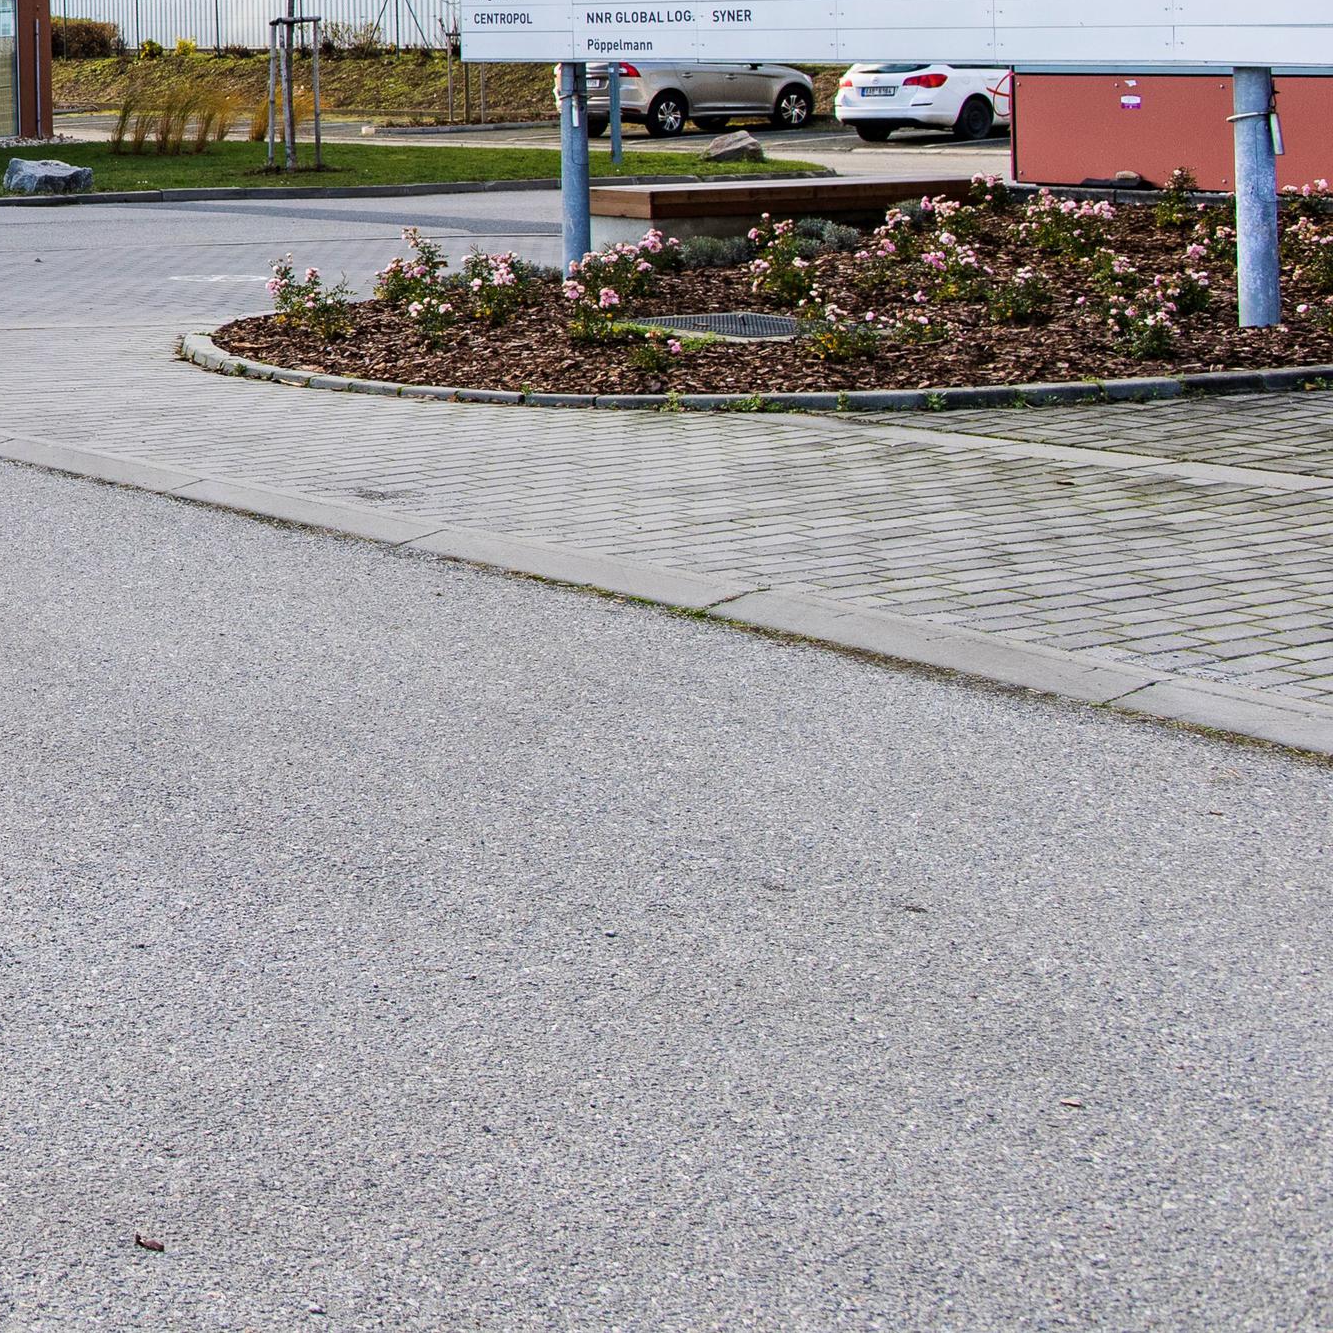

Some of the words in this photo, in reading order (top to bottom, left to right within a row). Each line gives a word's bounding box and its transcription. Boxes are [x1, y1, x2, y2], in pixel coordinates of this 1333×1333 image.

[473, 13, 533, 25] CENTROPOL
[586, 12, 612, 23] NNR
[615, 11, 664, 23] GLOBAL
[667, 10, 695, 22] LOG.
[712, 10, 752, 22] SYNER
[587, 39, 653, 54] Pöppelmann
